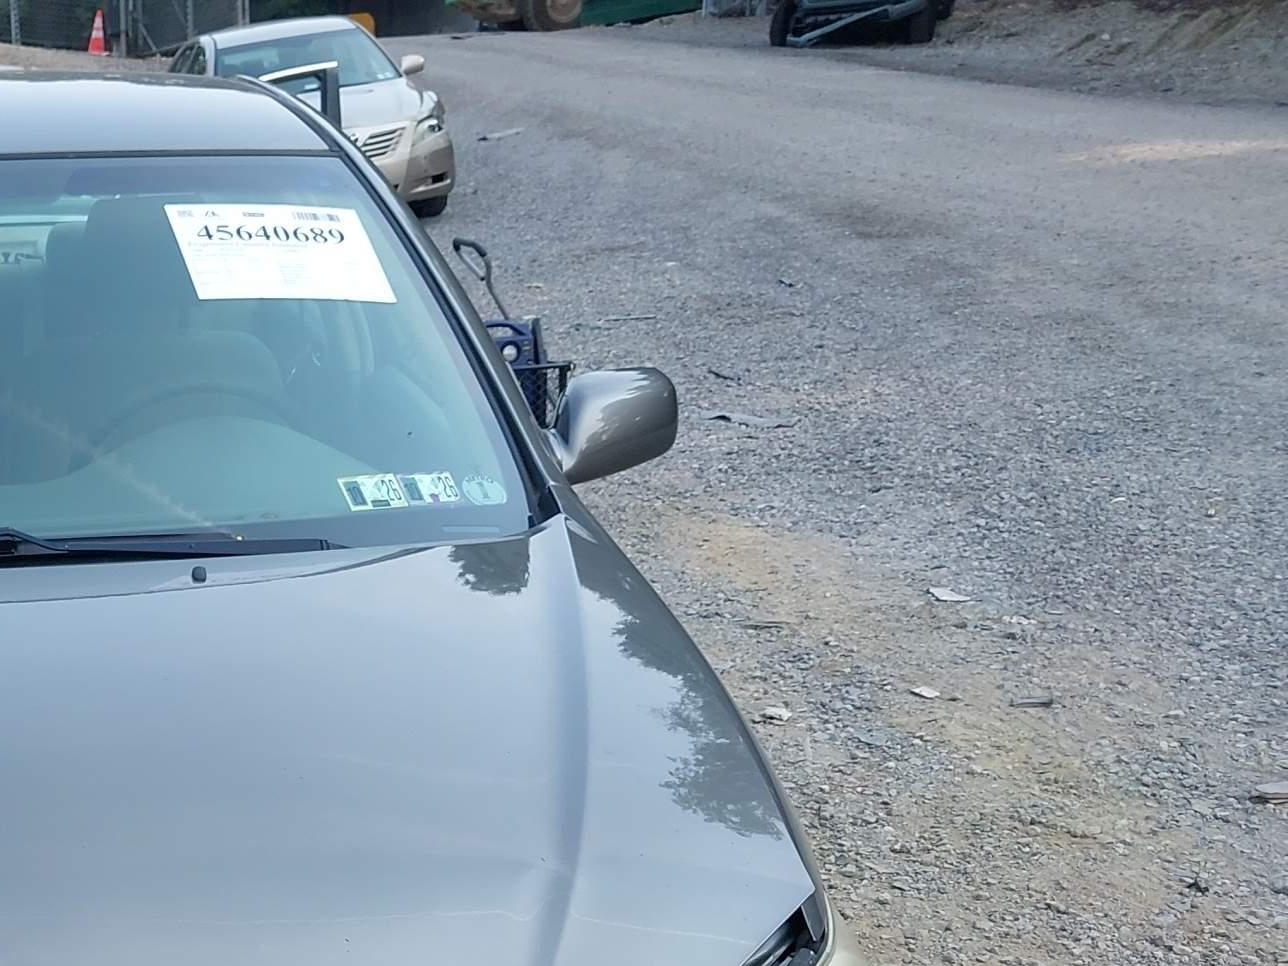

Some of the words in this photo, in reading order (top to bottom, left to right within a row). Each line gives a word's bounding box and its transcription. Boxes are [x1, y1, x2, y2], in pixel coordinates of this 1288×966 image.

[196, 224, 345, 244] 45640689
[380, 479, 402, 501] 26
[437, 476, 458, 498] 26
